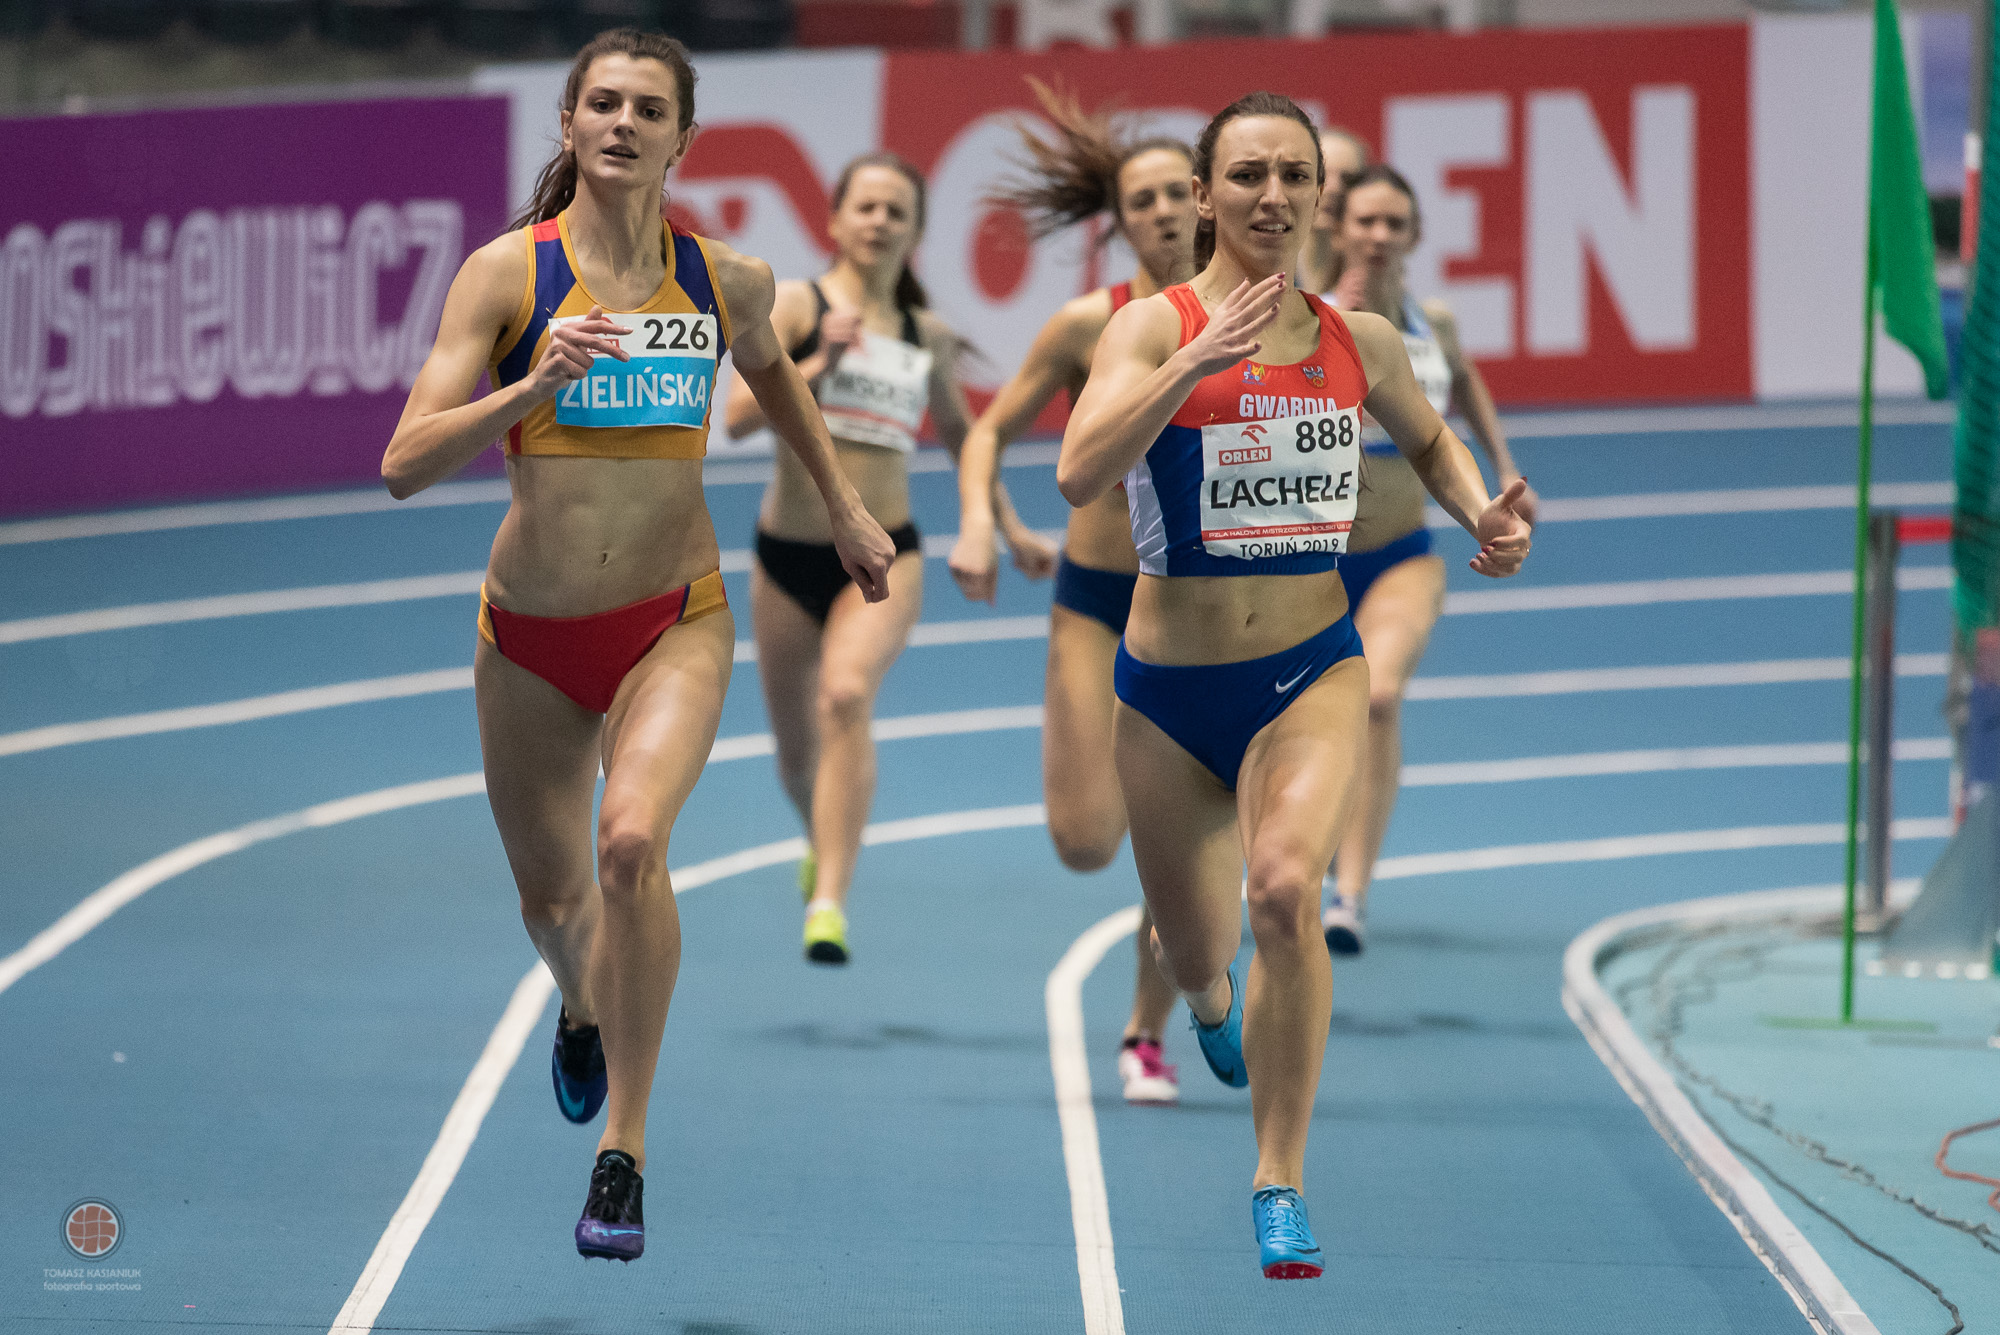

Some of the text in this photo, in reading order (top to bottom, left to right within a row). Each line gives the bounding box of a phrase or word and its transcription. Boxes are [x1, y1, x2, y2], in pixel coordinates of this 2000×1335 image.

[918, 85, 1697, 390] OEN
[643, 318, 709, 351] 226
[561, 366, 707, 409] ZIELIŃSKA
[1239, 393, 1338, 419] GWARDIA
[1295, 414, 1354, 453] 888
[1221, 448, 1269, 464] ORLEN
[1210, 471, 1353, 509] LACHELE
[1240, 537, 1339, 558] TORUŃ 2019
